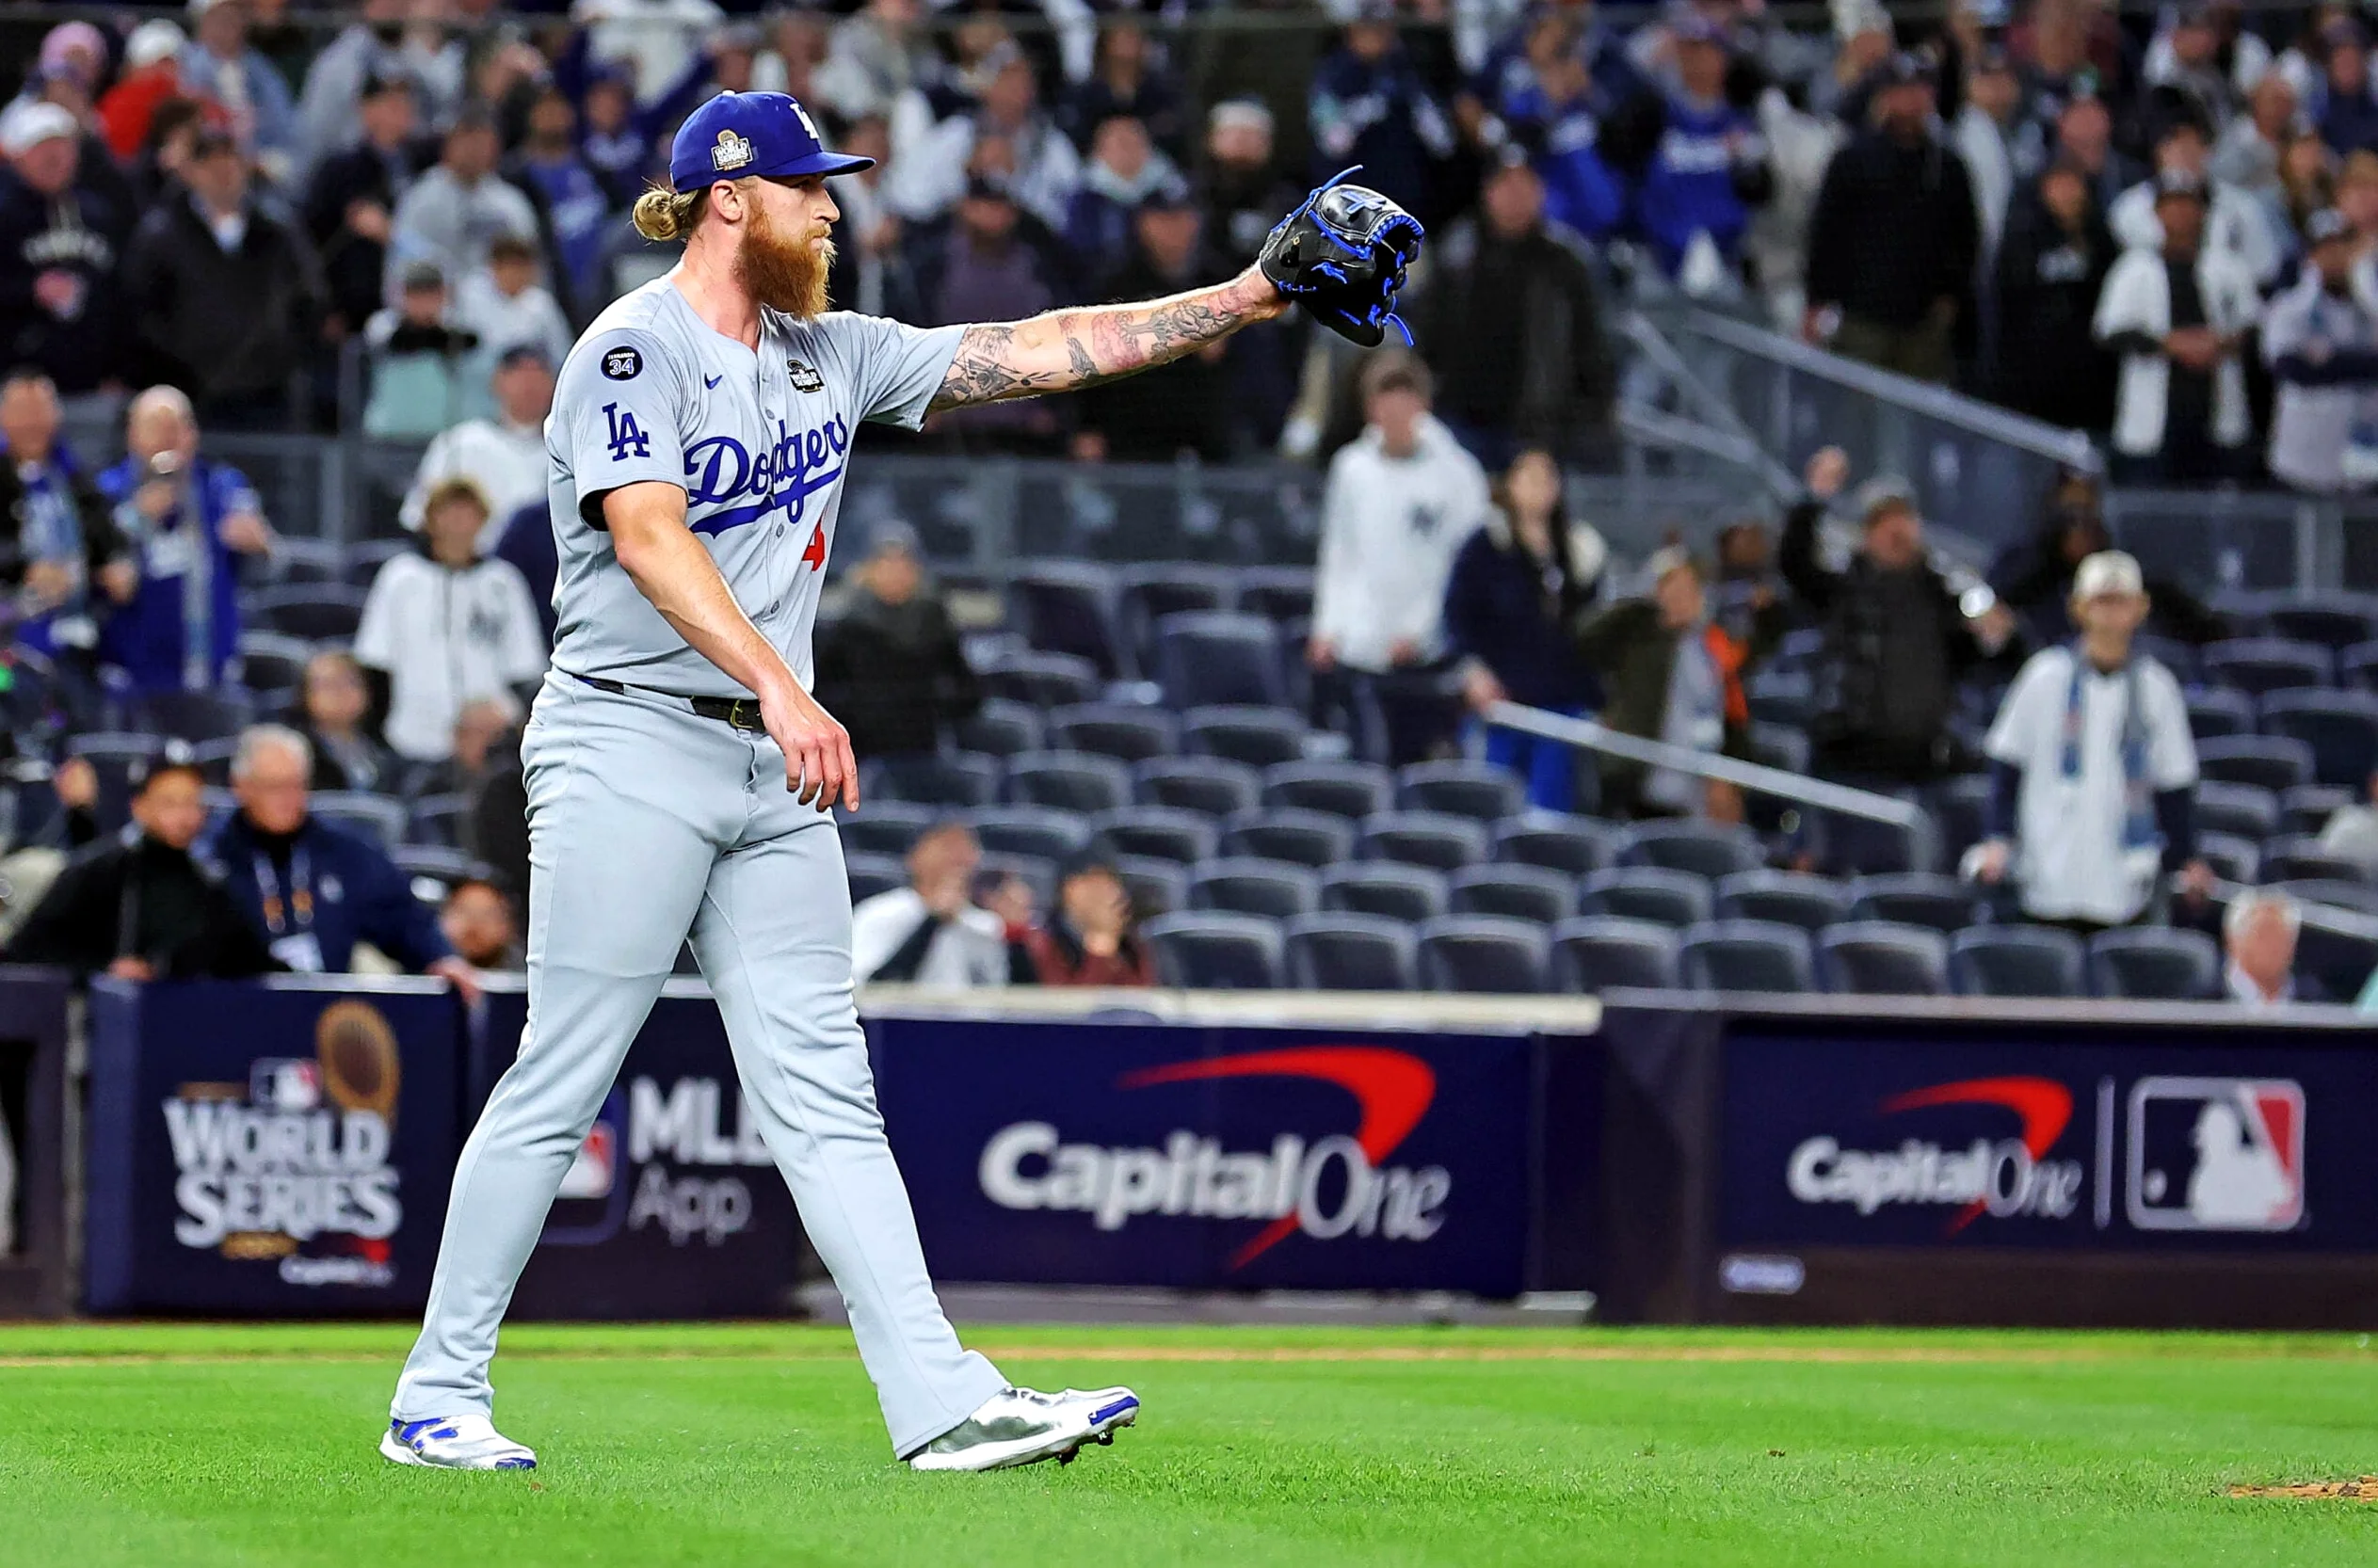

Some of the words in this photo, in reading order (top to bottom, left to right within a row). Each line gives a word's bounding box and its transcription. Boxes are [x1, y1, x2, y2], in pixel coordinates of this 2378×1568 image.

[608, 359, 635, 376] 34
[602, 401, 651, 462] LA
[683, 411, 847, 524] Dodgers
[161, 1097, 391, 1175] WORLD
[174, 1167, 403, 1248] SERIES
[628, 1162, 751, 1246] App
